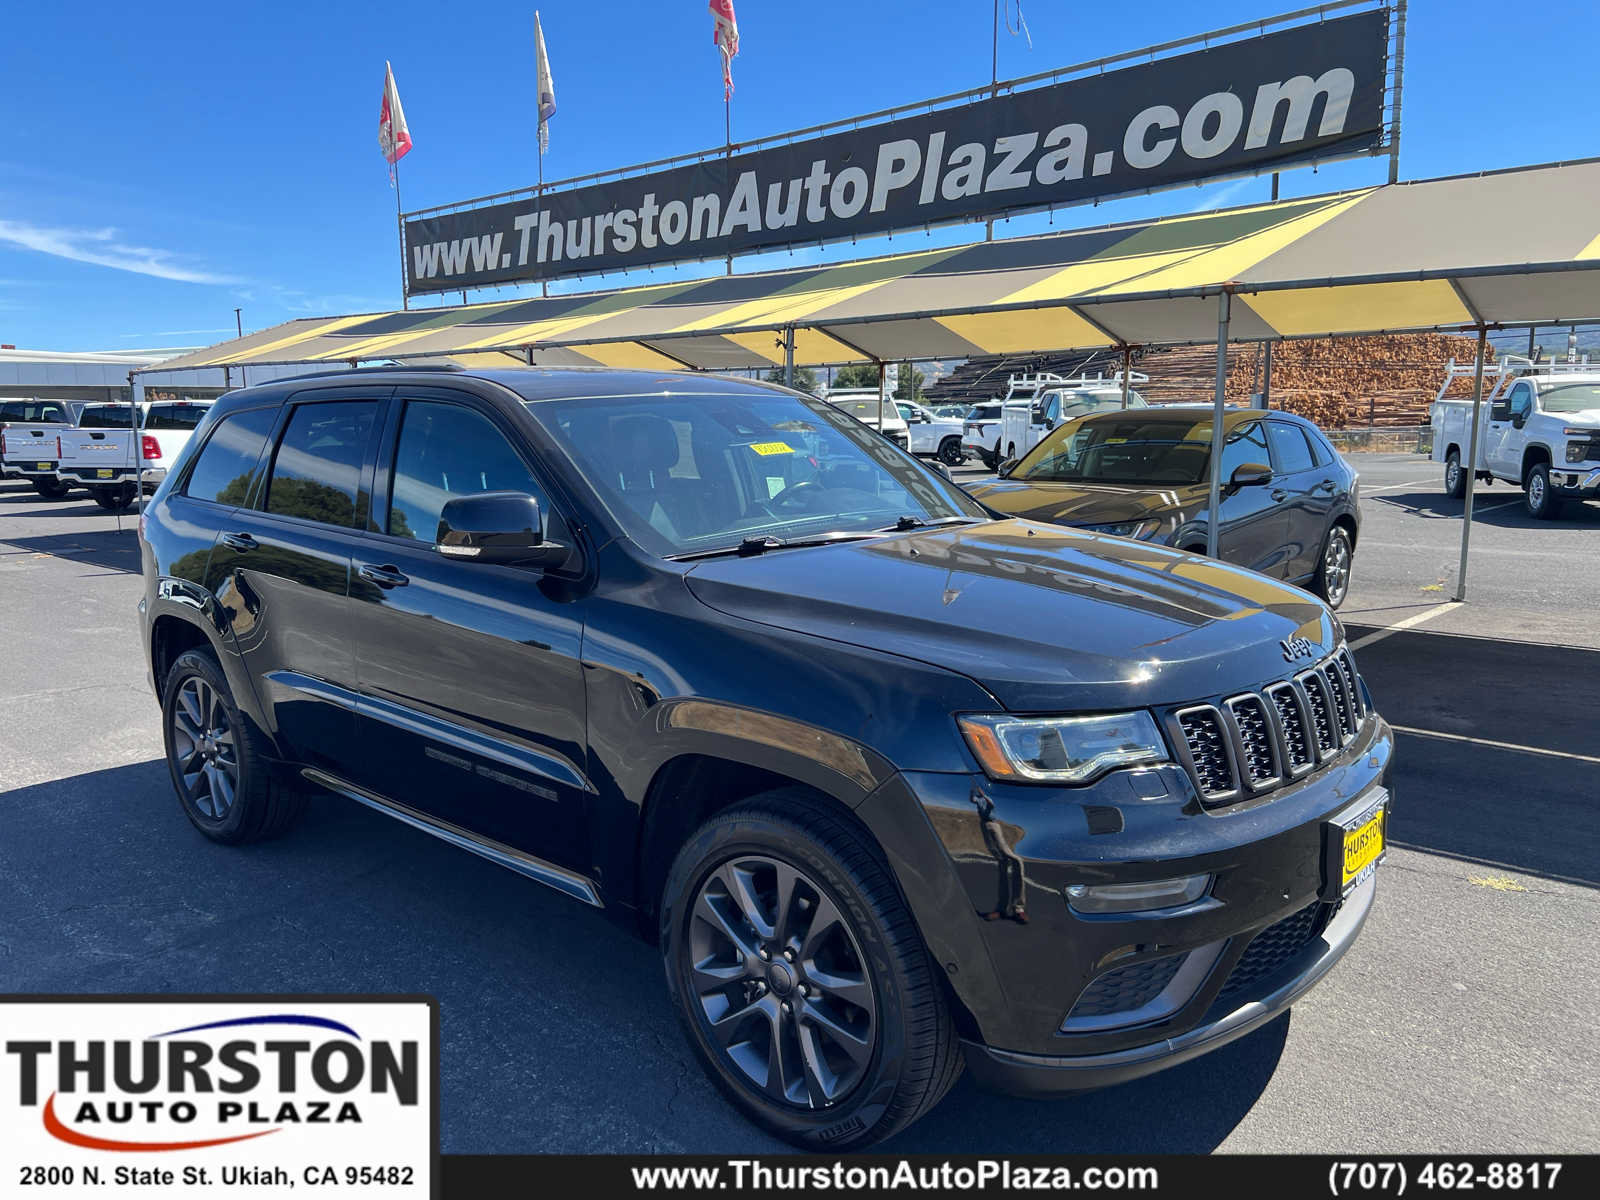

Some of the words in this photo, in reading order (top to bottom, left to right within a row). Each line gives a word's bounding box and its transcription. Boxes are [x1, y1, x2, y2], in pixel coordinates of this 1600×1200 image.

[413, 67, 1356, 281] www.ThurstonAutoPlaza.com
[1279, 636, 1313, 663] Jeep
[1343, 818, 1384, 860] HURSTON
